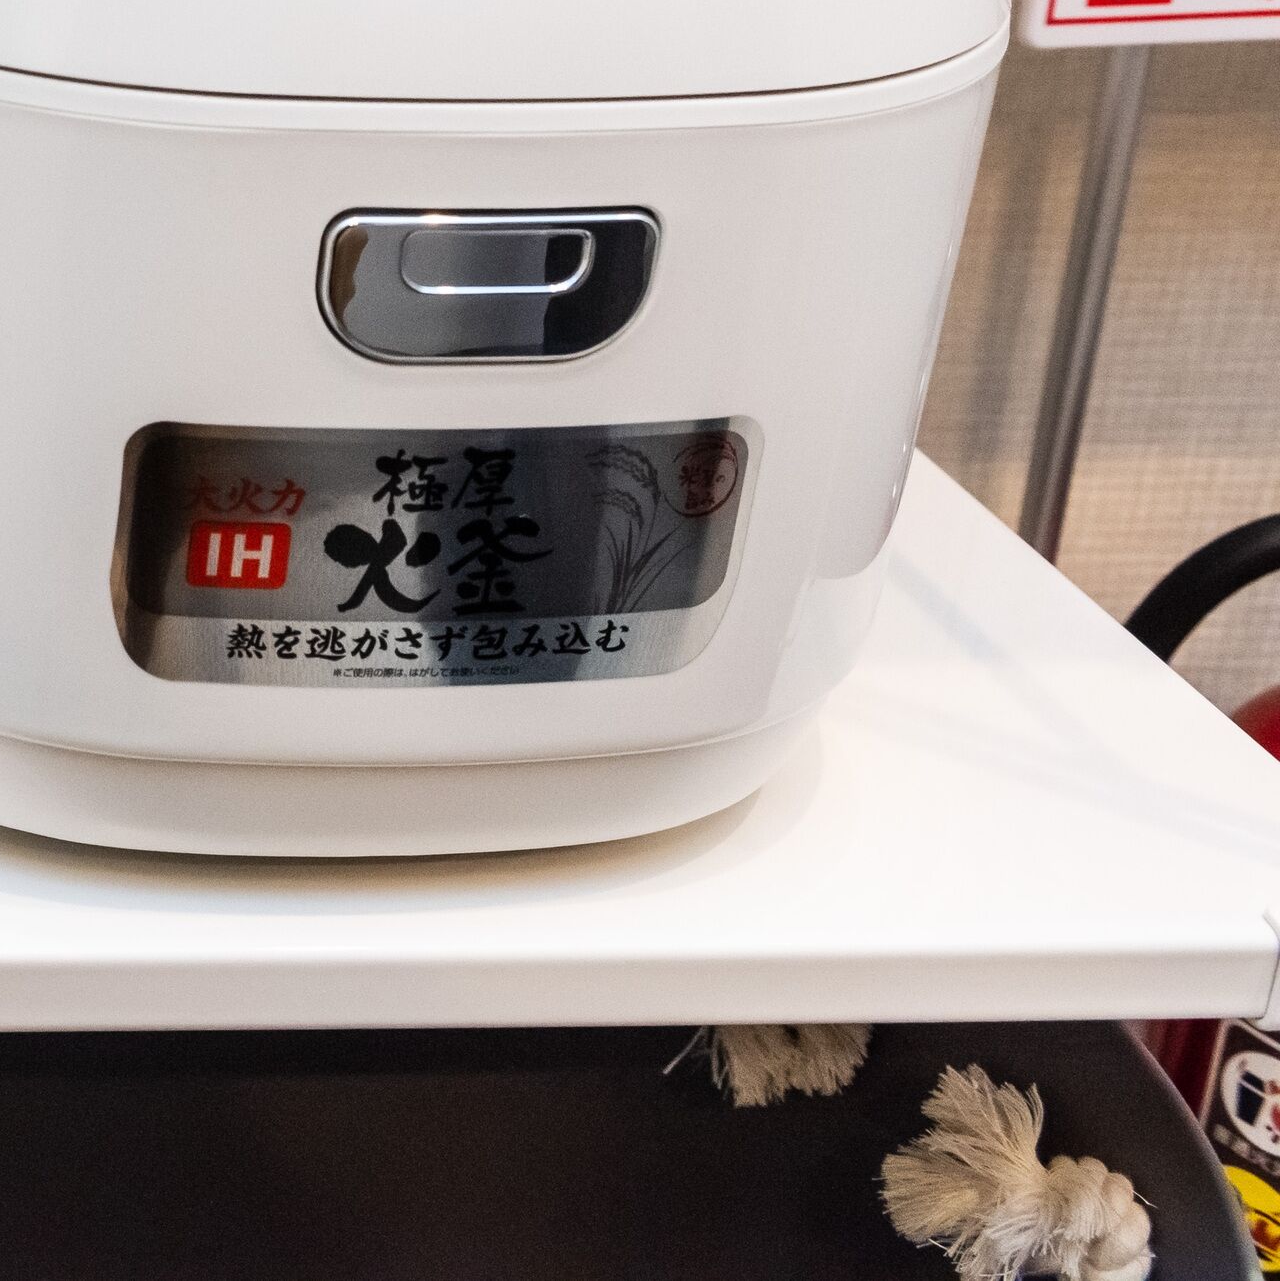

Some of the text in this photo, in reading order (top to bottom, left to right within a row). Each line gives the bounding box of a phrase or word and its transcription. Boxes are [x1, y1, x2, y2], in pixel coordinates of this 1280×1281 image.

[186, 478, 305, 516] 大火力
[373, 446, 516, 517] 極厚
[206, 533, 273, 578] IH
[323, 516, 553, 615] 火釜
[226, 620, 627, 661] 熱を逃がさず包み込む
